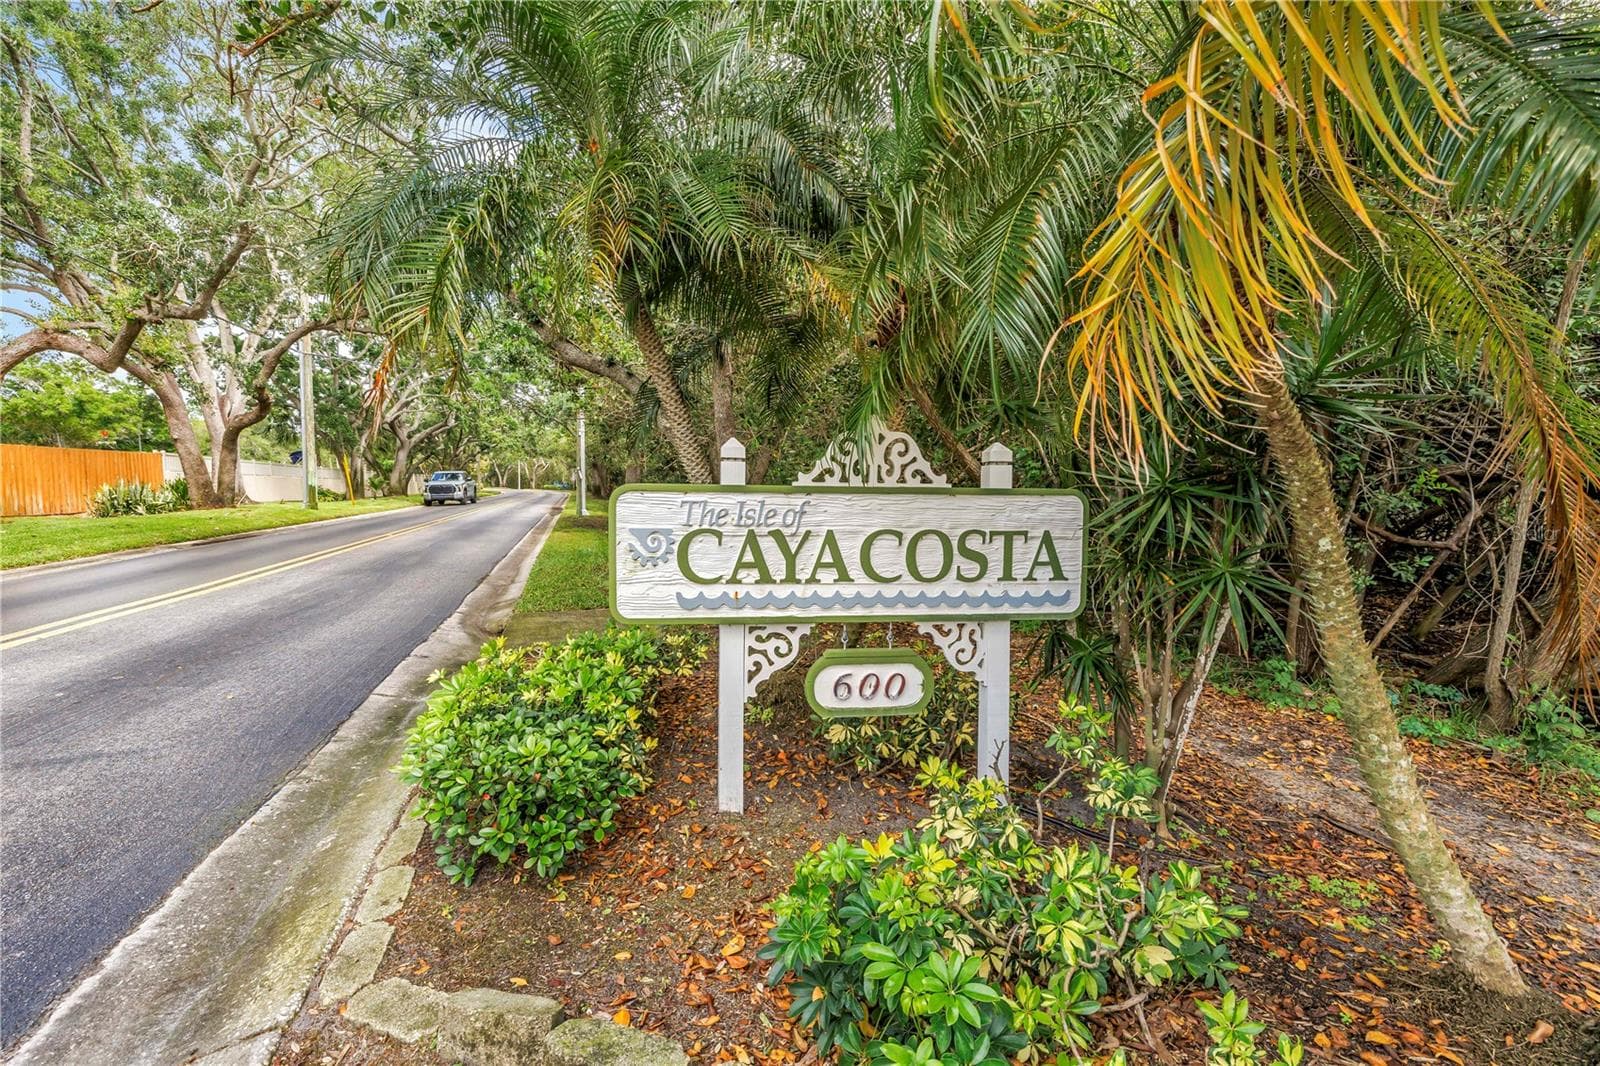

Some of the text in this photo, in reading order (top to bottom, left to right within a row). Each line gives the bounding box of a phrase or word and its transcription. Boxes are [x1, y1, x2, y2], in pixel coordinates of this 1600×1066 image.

[680, 499, 812, 537] The Isle of
[832, 672, 907, 701] 600
